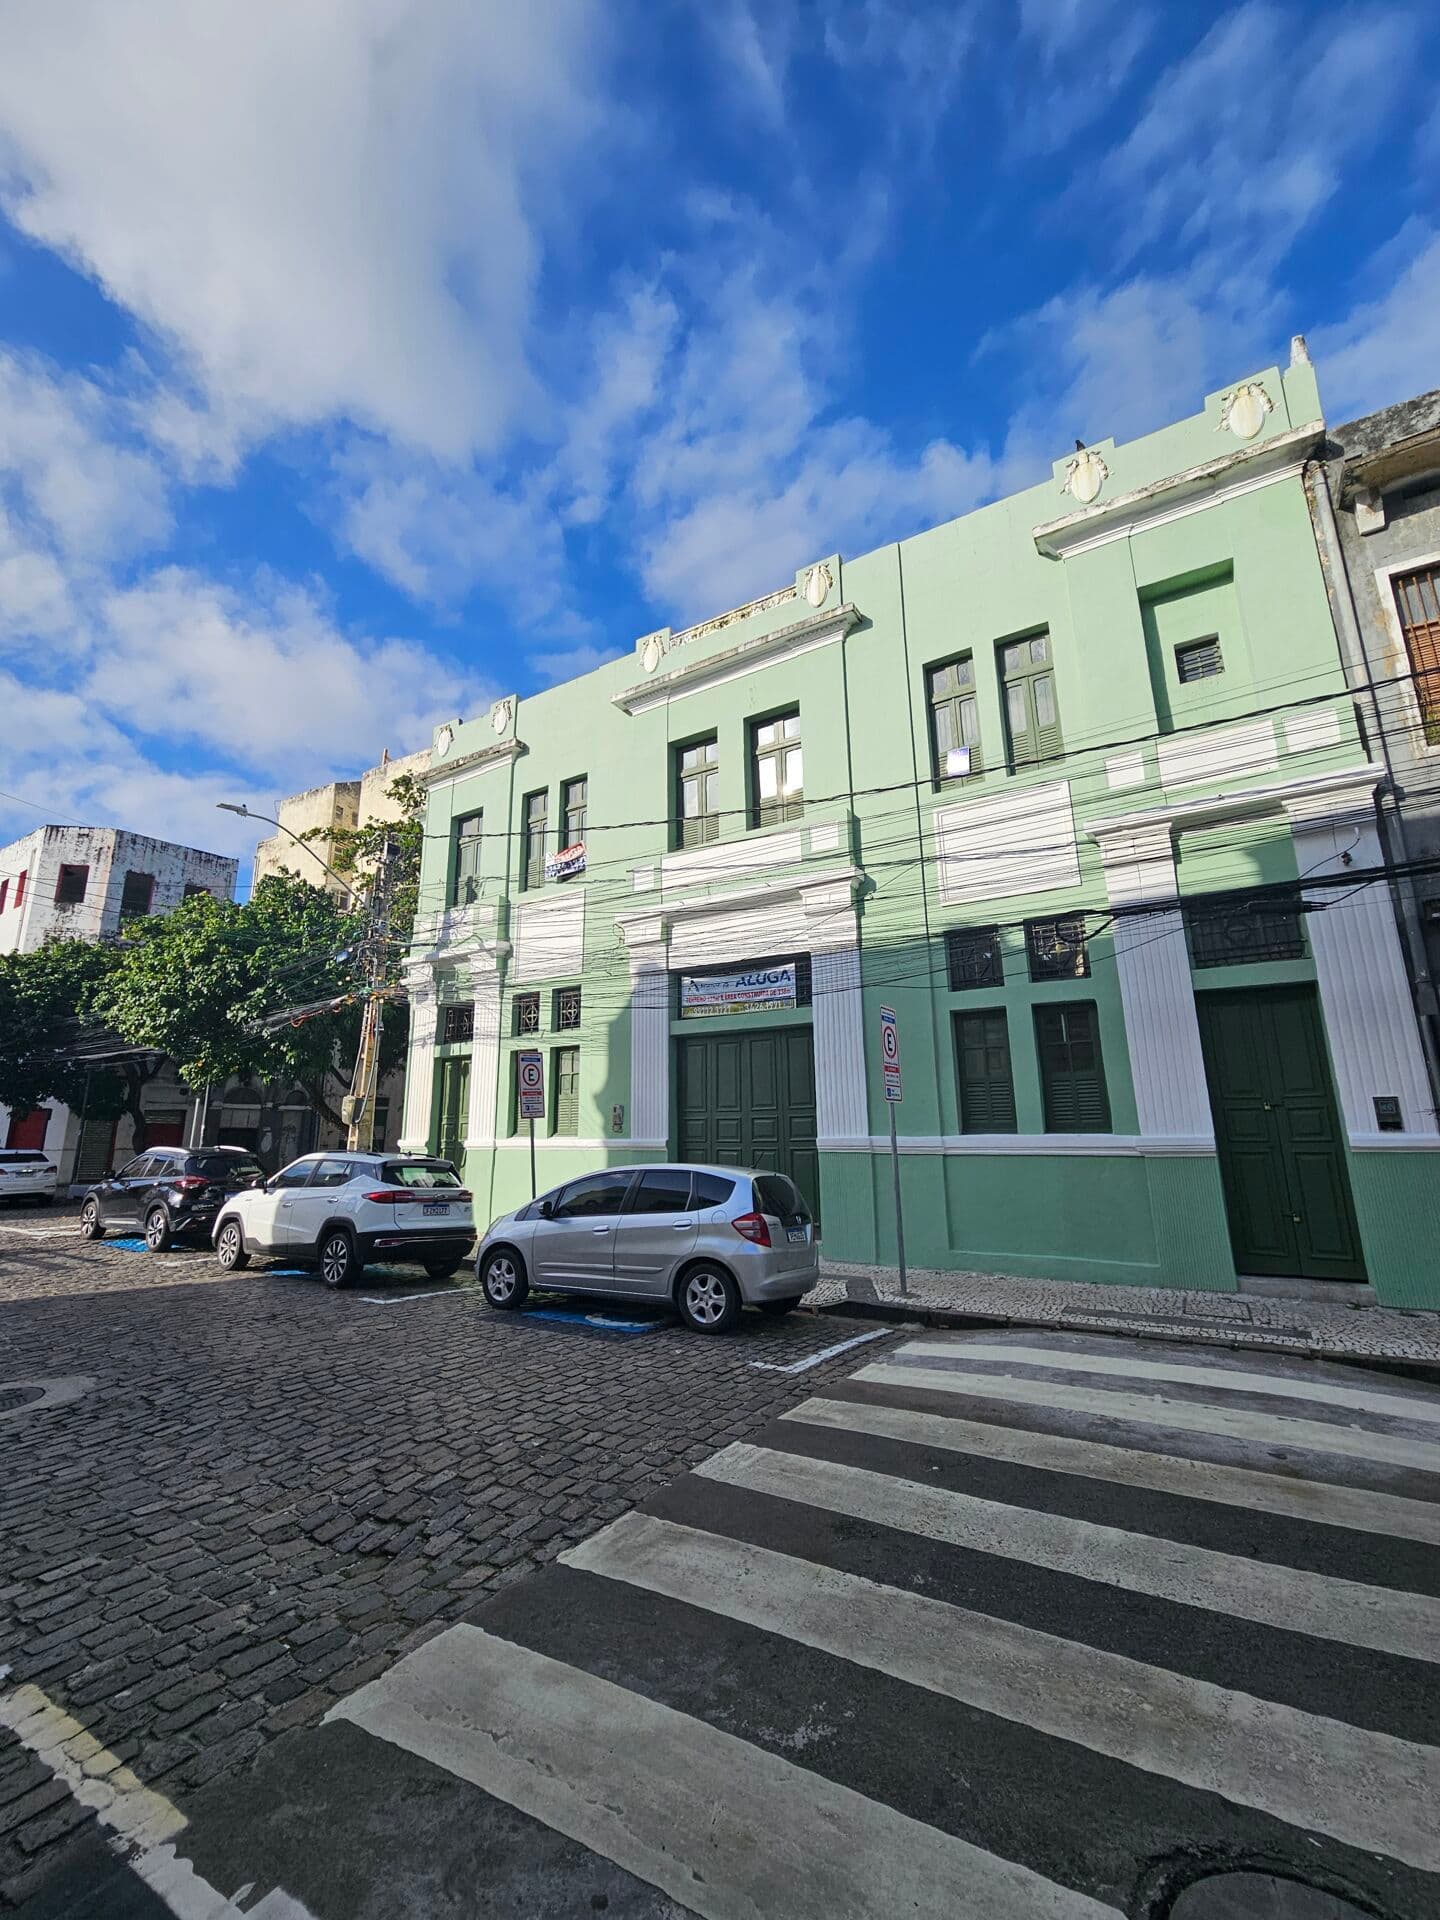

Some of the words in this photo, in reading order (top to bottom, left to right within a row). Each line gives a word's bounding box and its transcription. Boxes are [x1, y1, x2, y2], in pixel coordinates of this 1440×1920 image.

[735, 970, 791, 987] ALUGA
[888, 1033, 893, 1051] E
[528, 1069, 535, 1082] E
